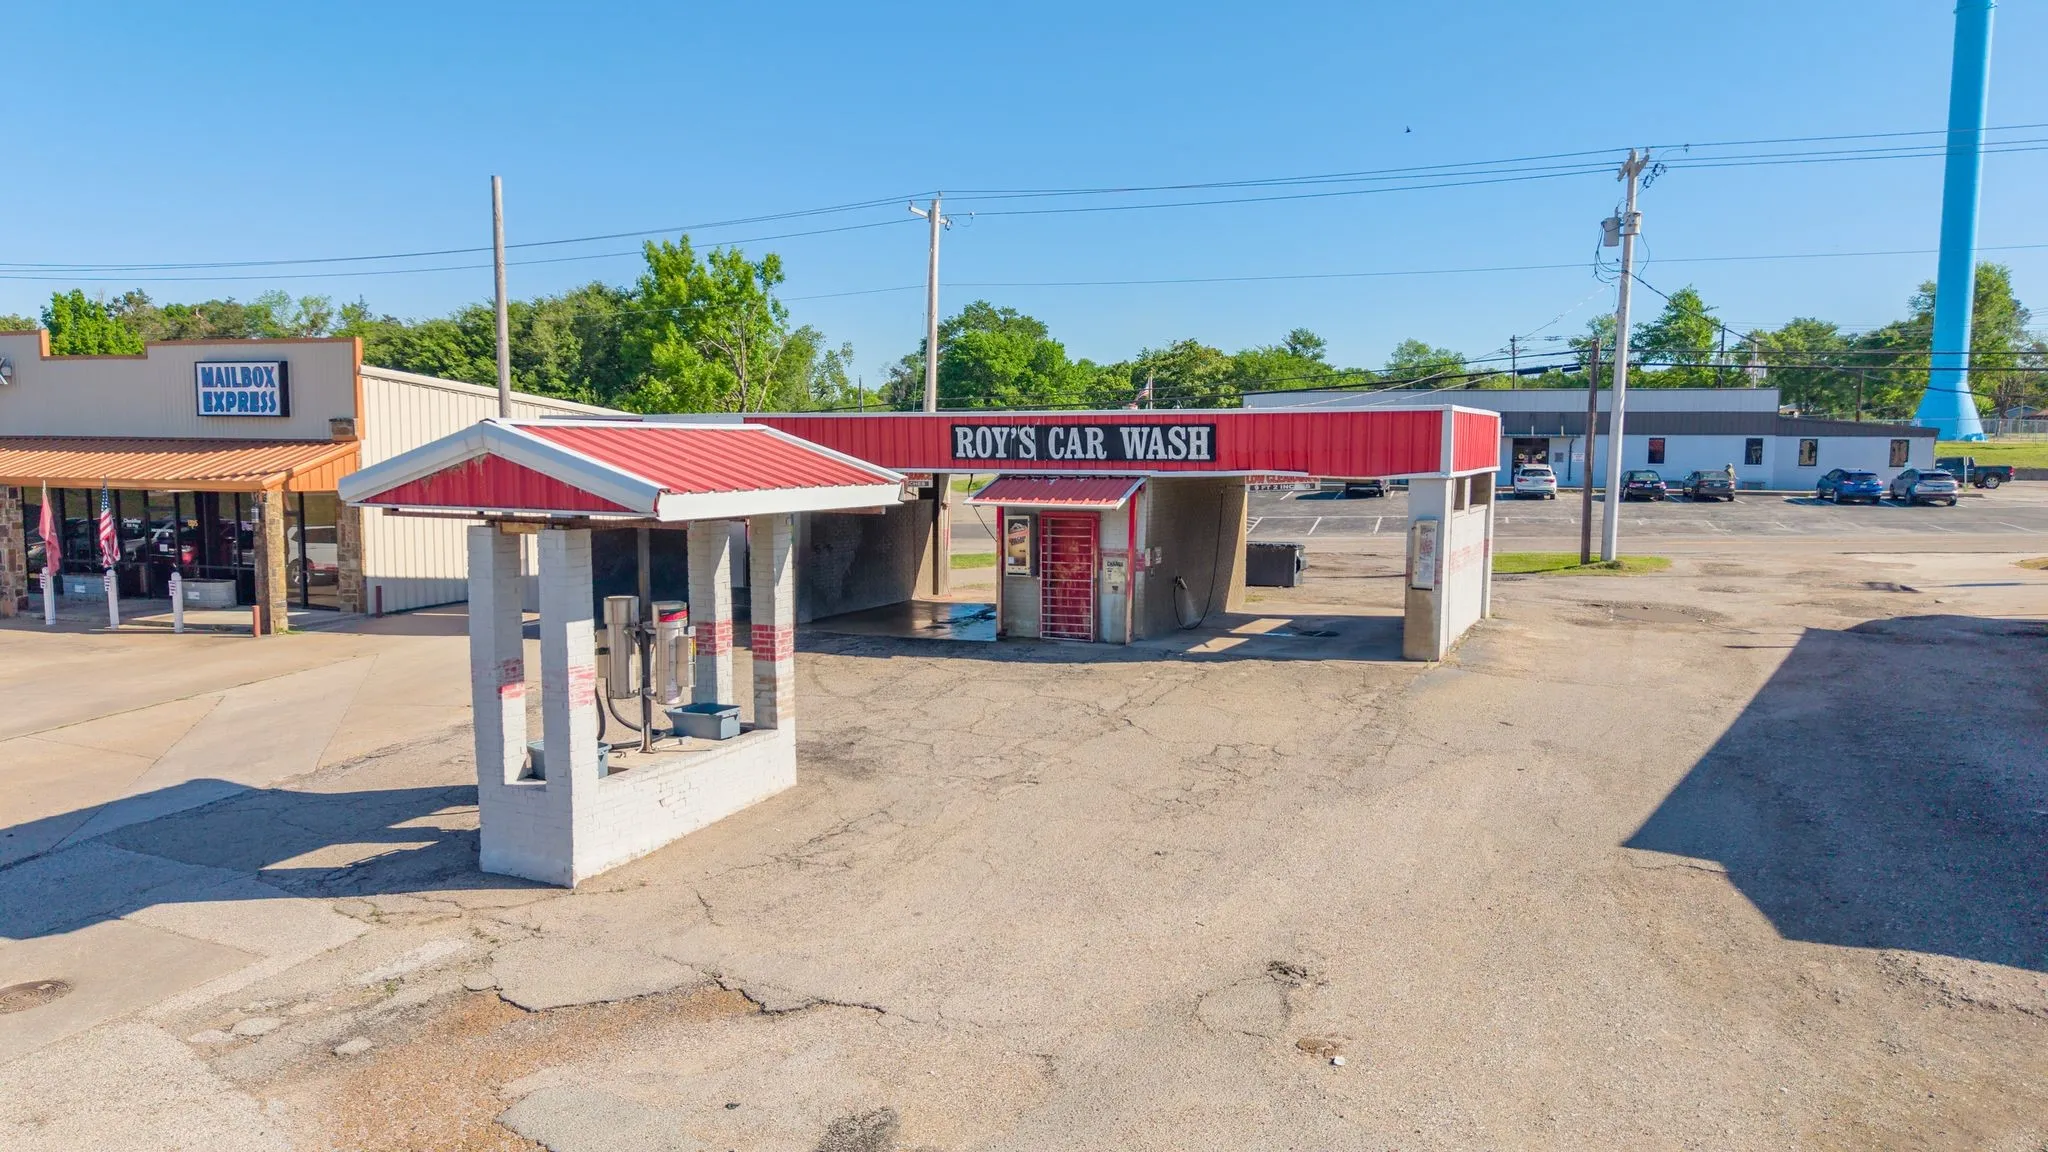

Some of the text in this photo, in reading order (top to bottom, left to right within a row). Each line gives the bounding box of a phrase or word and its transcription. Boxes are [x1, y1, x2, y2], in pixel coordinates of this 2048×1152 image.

[201, 366, 276, 388] MAILBOX
[203, 390, 277, 413] EXPRESS
[954, 426, 1211, 460] ROY'S CAR WASH
